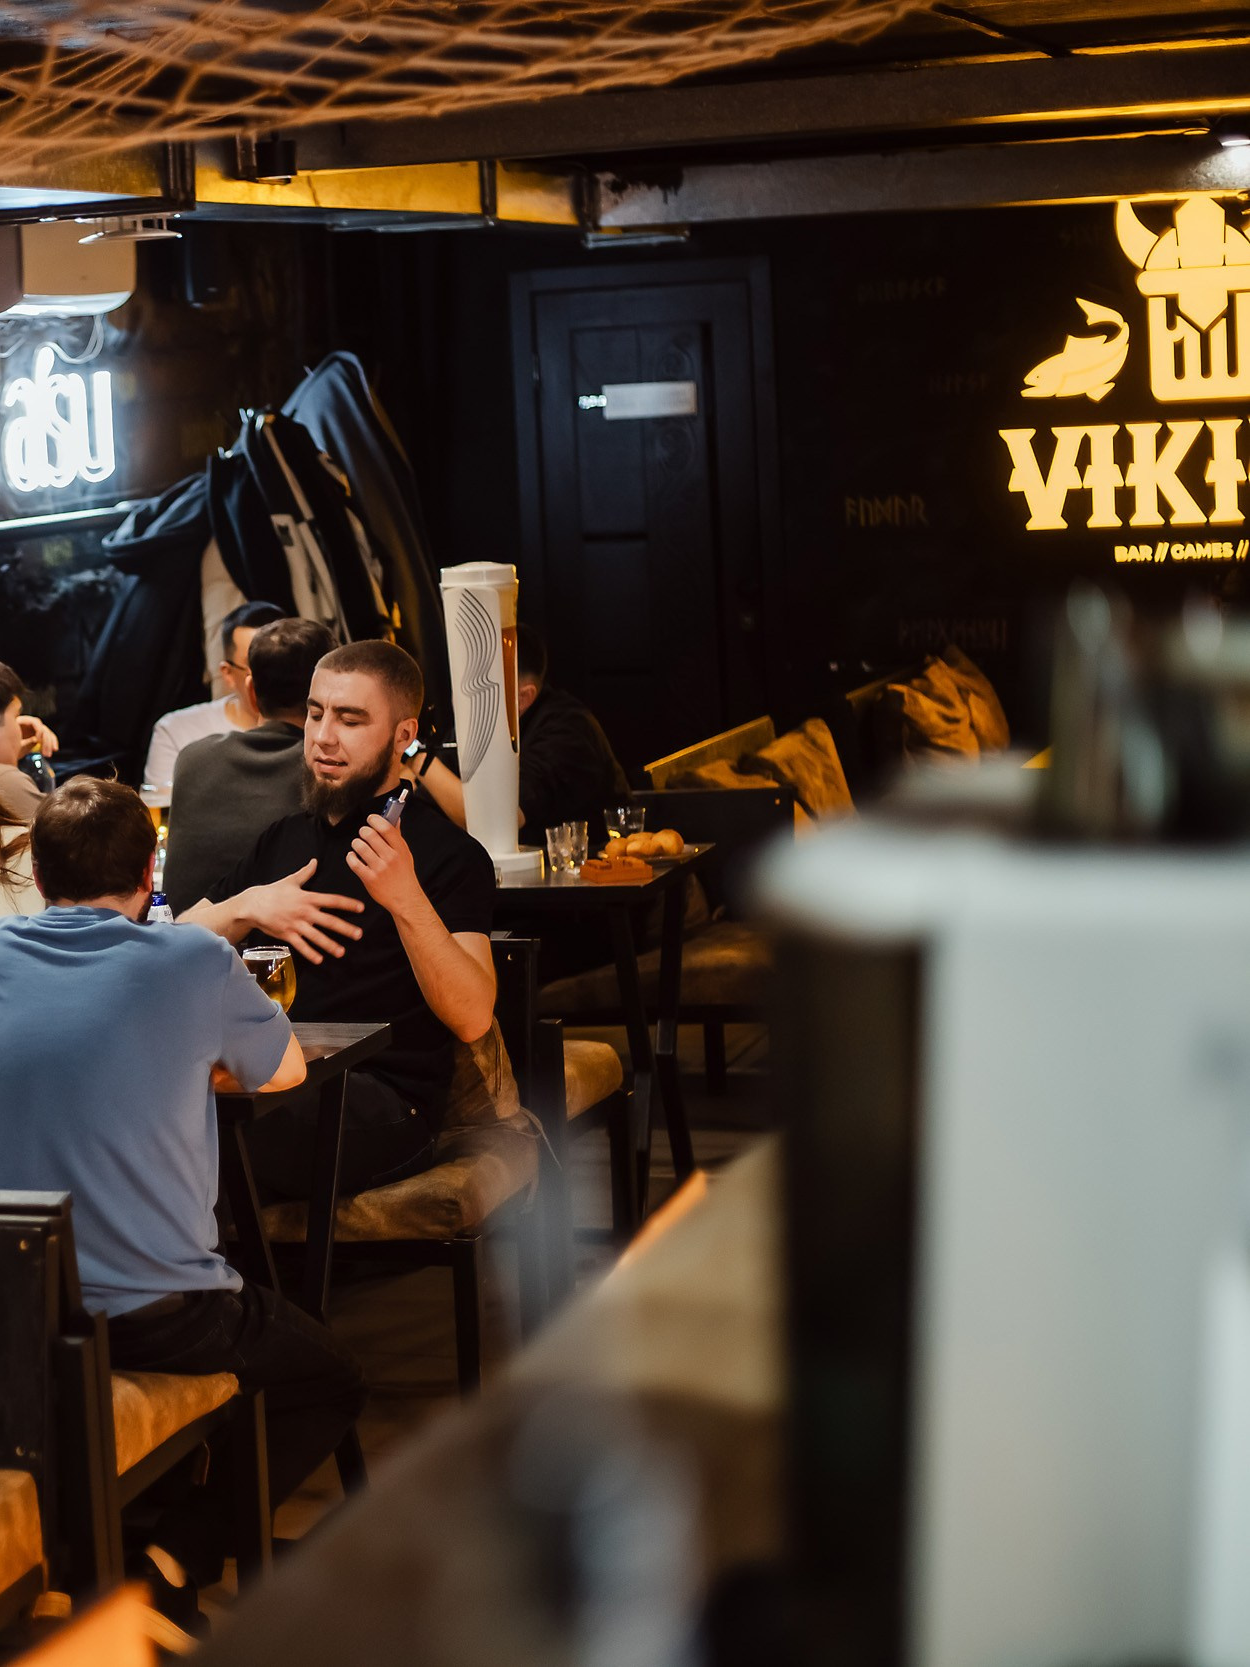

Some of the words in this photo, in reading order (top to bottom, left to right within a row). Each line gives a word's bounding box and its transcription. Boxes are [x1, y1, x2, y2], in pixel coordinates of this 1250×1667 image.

[998, 418, 1250, 531] VIKI
[1114, 544, 1153, 563] BAR
[1170, 541, 1235, 561] GAMES
